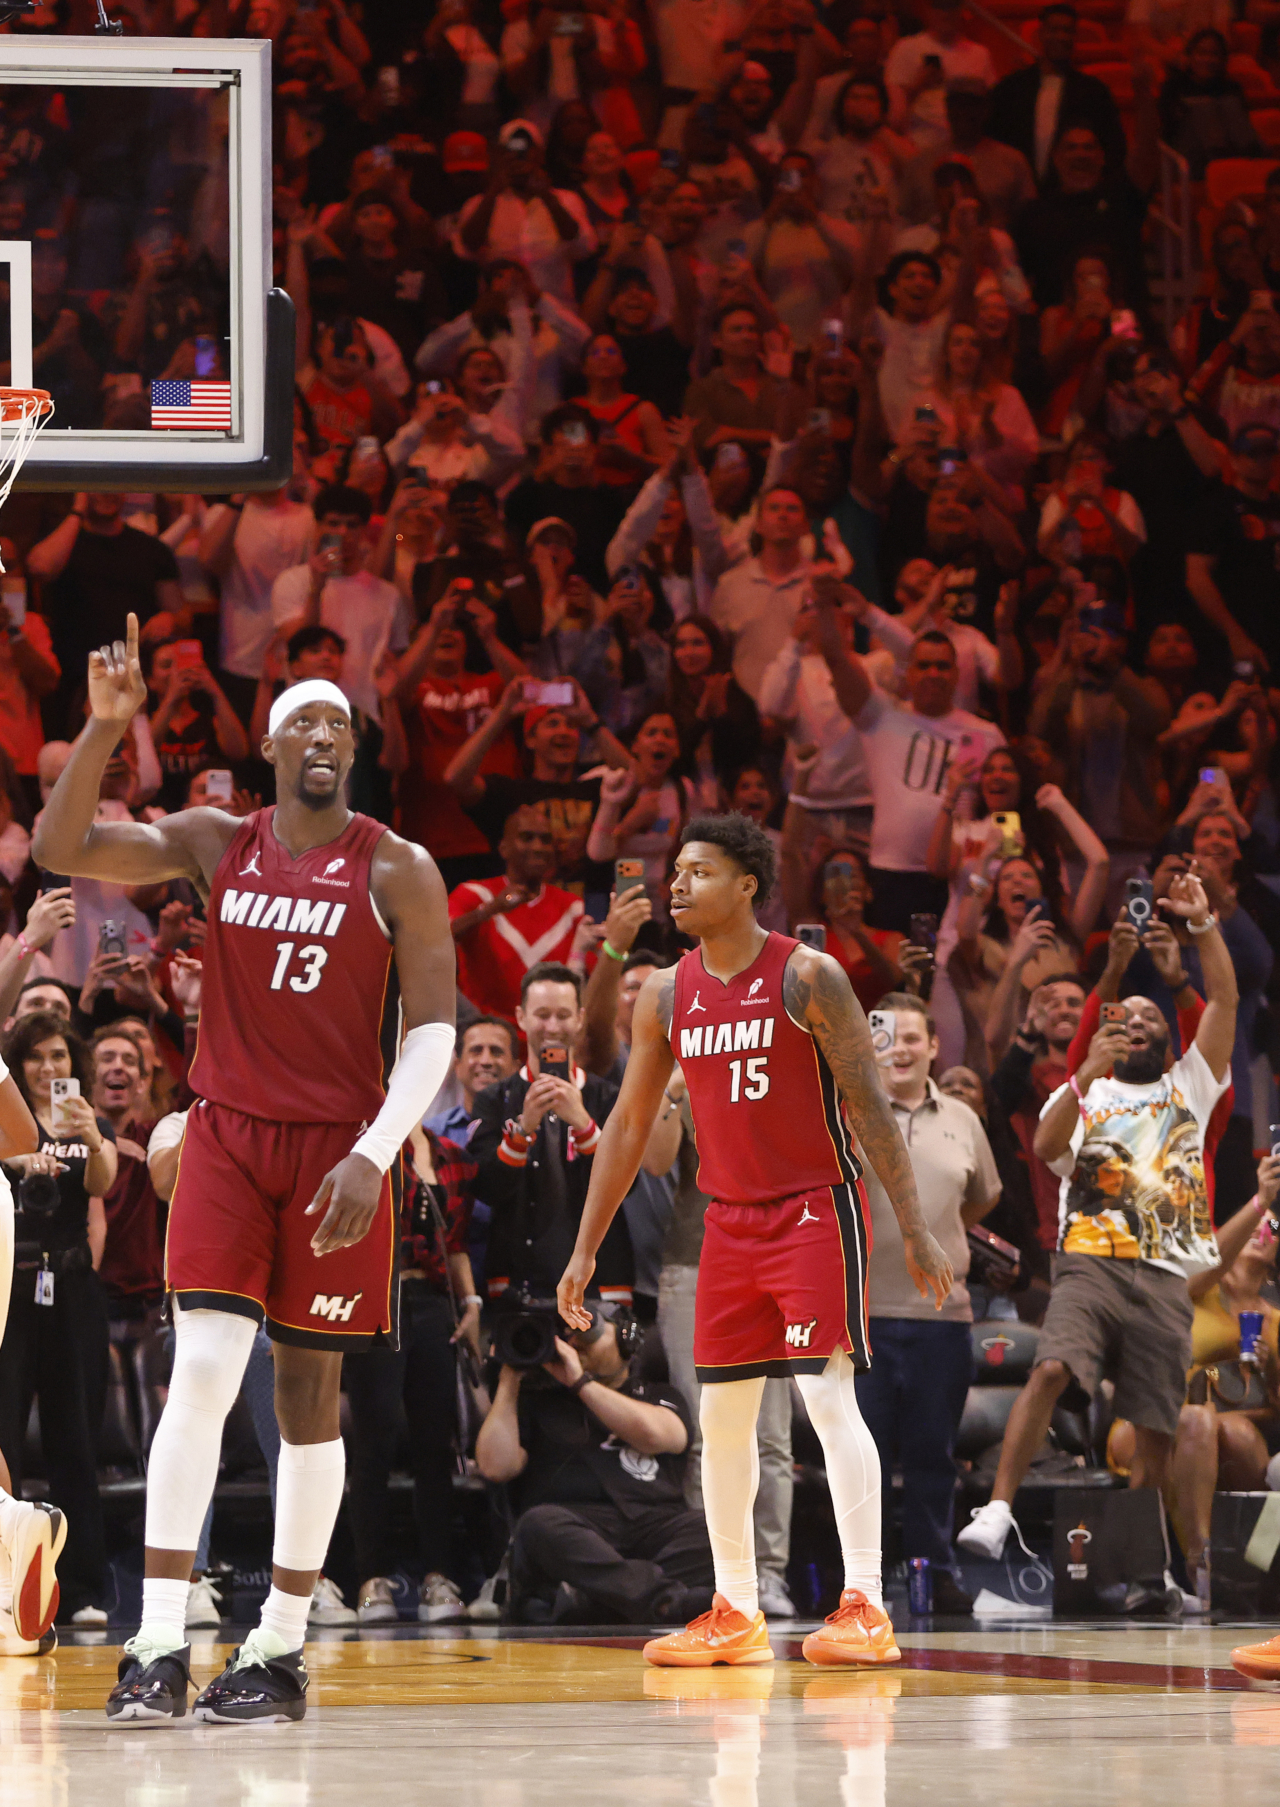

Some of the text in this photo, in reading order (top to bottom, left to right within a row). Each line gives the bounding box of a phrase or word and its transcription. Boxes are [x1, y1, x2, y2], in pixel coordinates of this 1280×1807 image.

[312, 876, 350, 888] Robinhood
[220, 888, 348, 937] MIAMI
[270, 942, 329, 994] 13
[740, 996, 771, 1007] Robinhood
[680, 1017, 776, 1060] MIAMI
[728, 1056, 771, 1104] 15
[41, 1141, 89, 1159] HEAT
